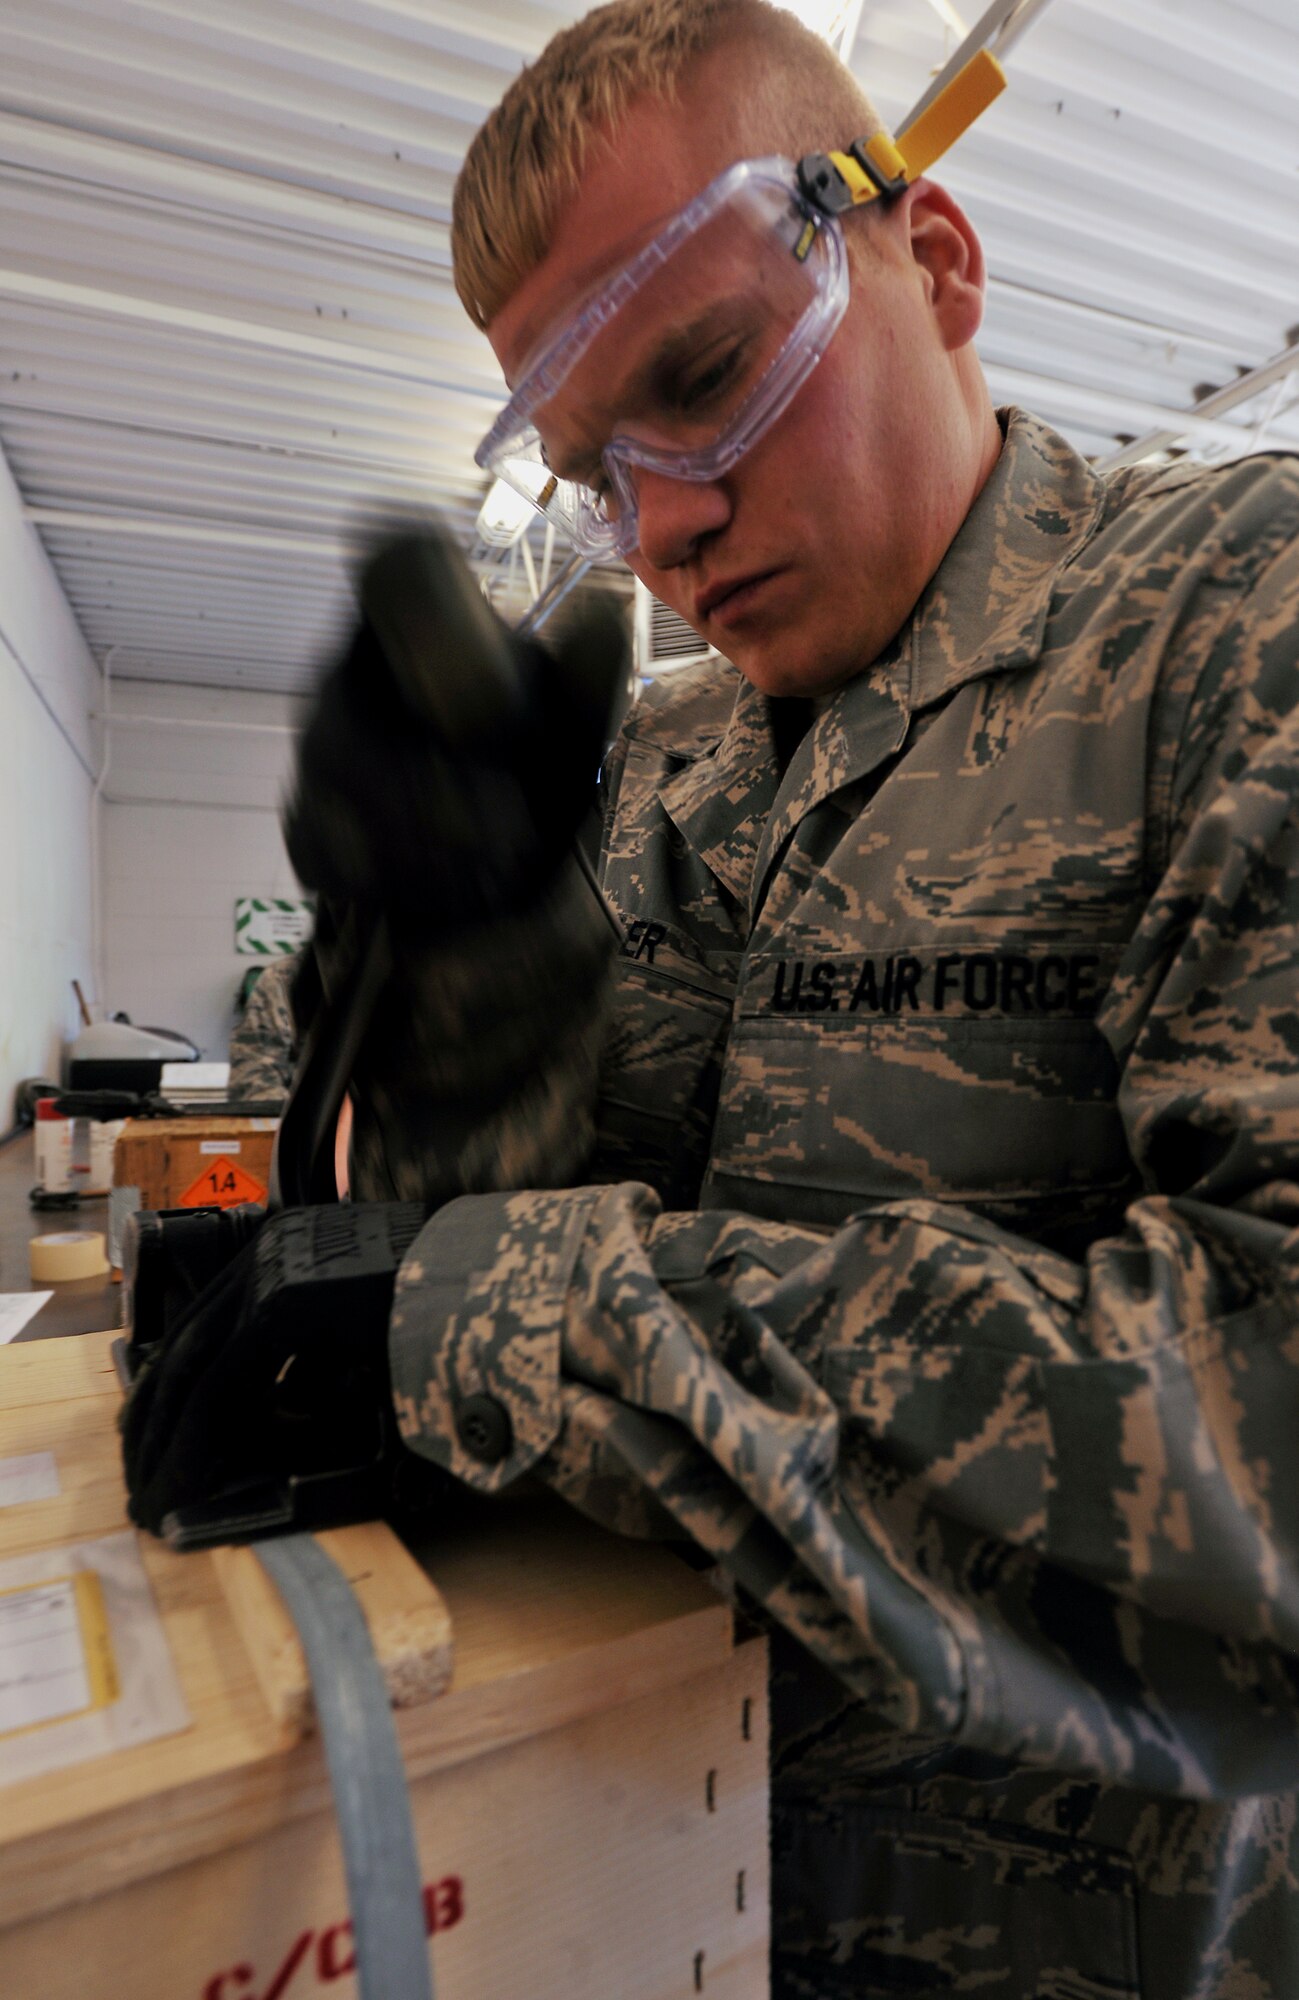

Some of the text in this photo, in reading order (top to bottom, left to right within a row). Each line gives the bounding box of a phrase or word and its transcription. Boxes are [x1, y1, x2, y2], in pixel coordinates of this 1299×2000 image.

[771, 953, 1100, 1013] U.S. AIR FORCE
[208, 1171, 237, 1194] 1.4
